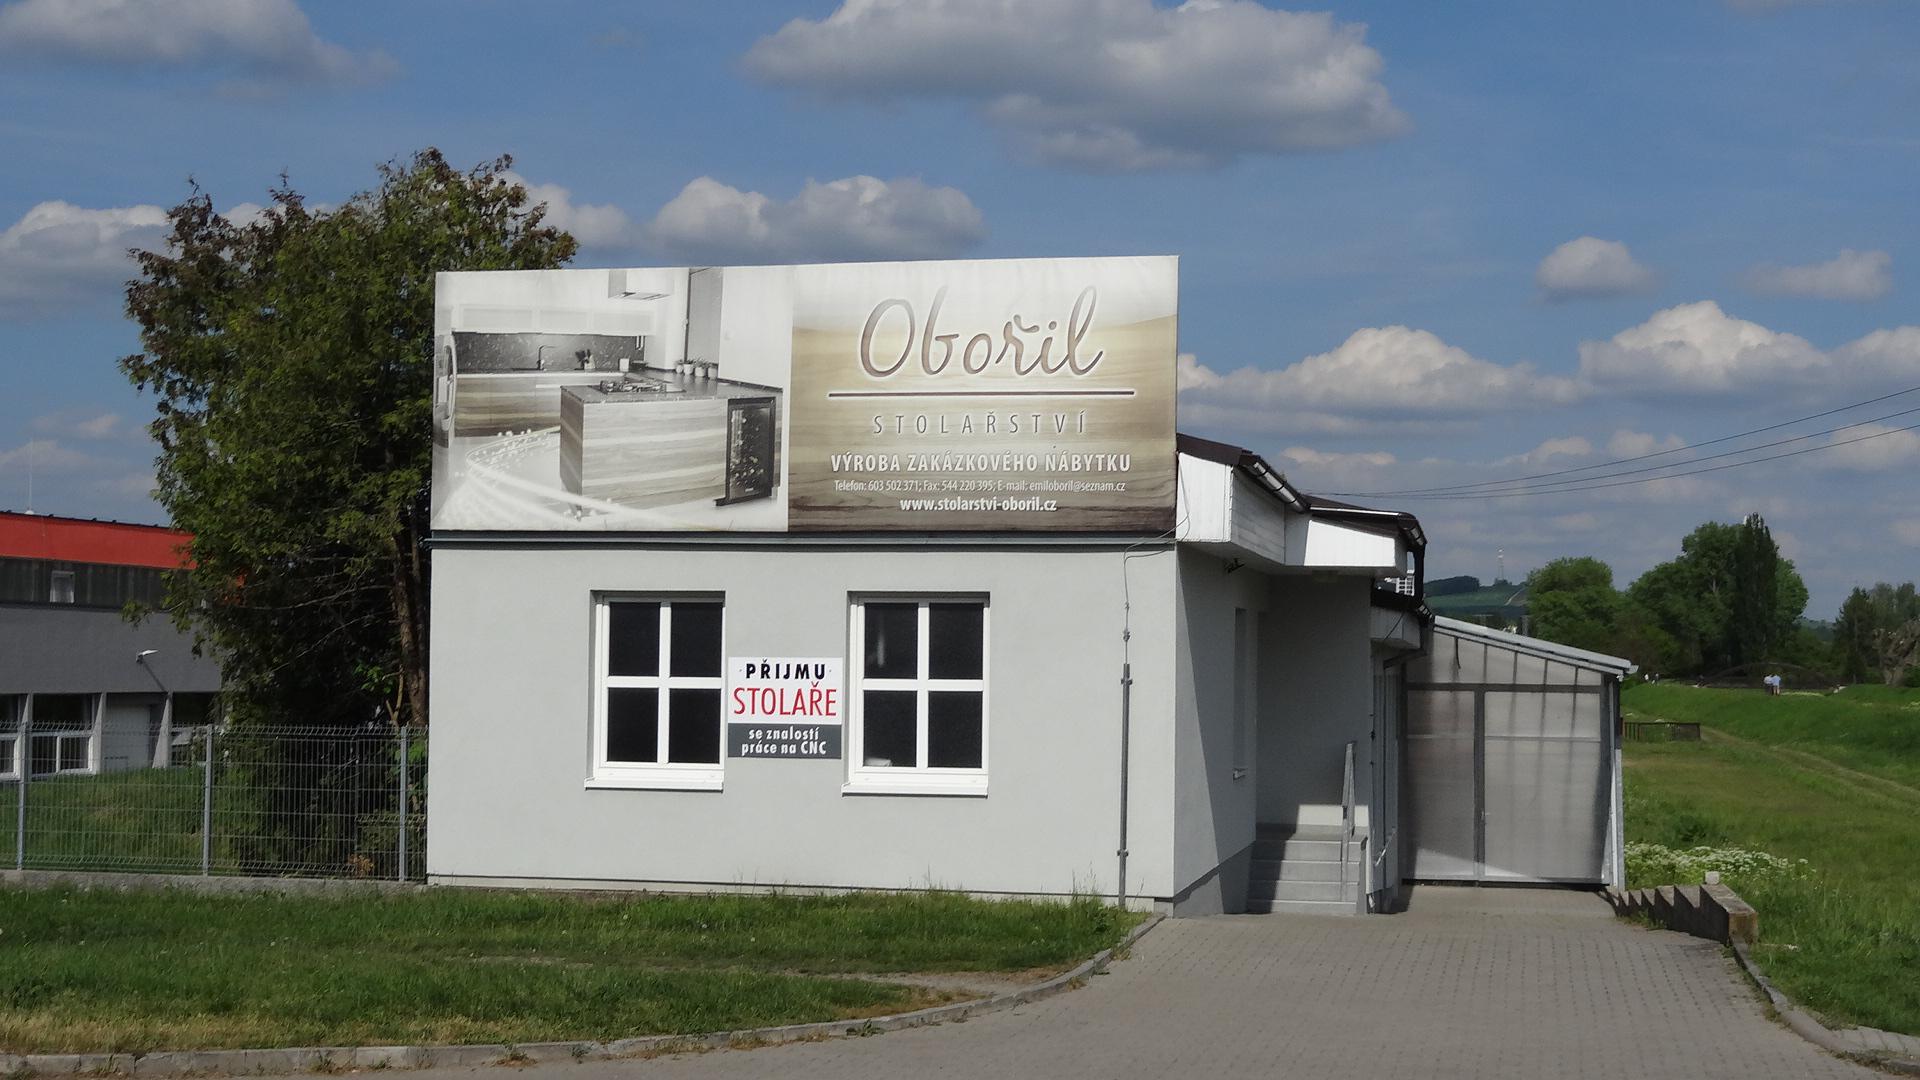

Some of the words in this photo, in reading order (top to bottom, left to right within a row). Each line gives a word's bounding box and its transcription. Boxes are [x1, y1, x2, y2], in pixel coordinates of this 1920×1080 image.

[861, 284, 1103, 377] Obořil
[873, 410, 1086, 434] STOLAŘSTVÍ
[831, 451, 901, 472] VÝROBA
[907, 450, 1038, 471] ZAKÁZKOVÉHO
[1045, 451, 1131, 471] NÁBYTKU
[834, 479, 867, 492] Telefon:
[868, 479, 884, 491] 603
[886, 479, 901, 491] 502
[923, 480, 940, 491] Fax:
[941, 479, 957, 491] 544
[959, 480, 975, 491] 220
[997, 480, 1028, 491] E-mail:
[901, 496, 1057, 511] www.stolarstvi-oboril.cz
[746, 659, 825, 679] PŘIJMU
[734, 681, 837, 716] STOLAŘE
[748, 729, 763, 740] se
[766, 725, 820, 740] znalostí
[741, 740, 777, 756] práce
[780, 743, 797, 754] na
[800, 741, 827, 754] CNC
